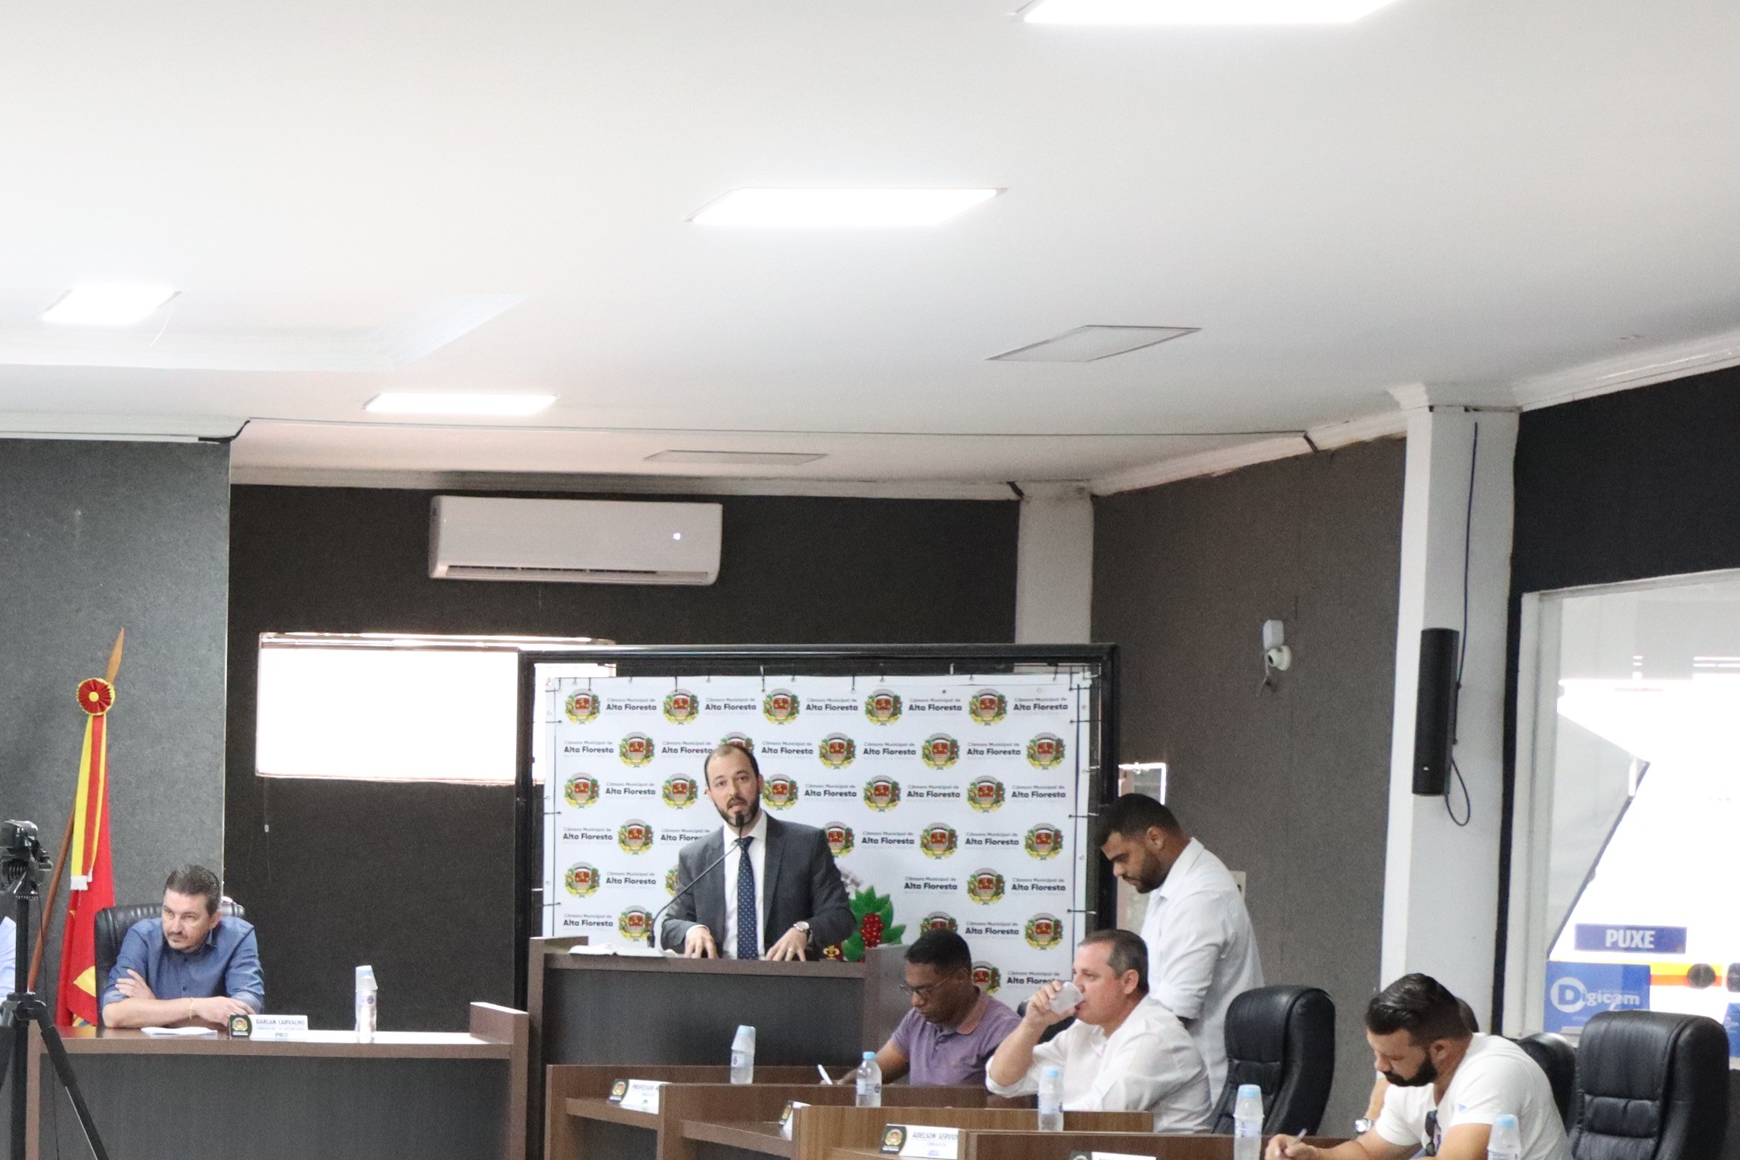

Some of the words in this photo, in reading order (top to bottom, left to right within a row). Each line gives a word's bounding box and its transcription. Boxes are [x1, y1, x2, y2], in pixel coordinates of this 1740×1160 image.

[905, 882, 922, 890] Alta
[923, 882, 958, 890] Floresta
[1605, 929, 1655, 948] PUXE
[912, 1132, 937, 1140] ADELSON
